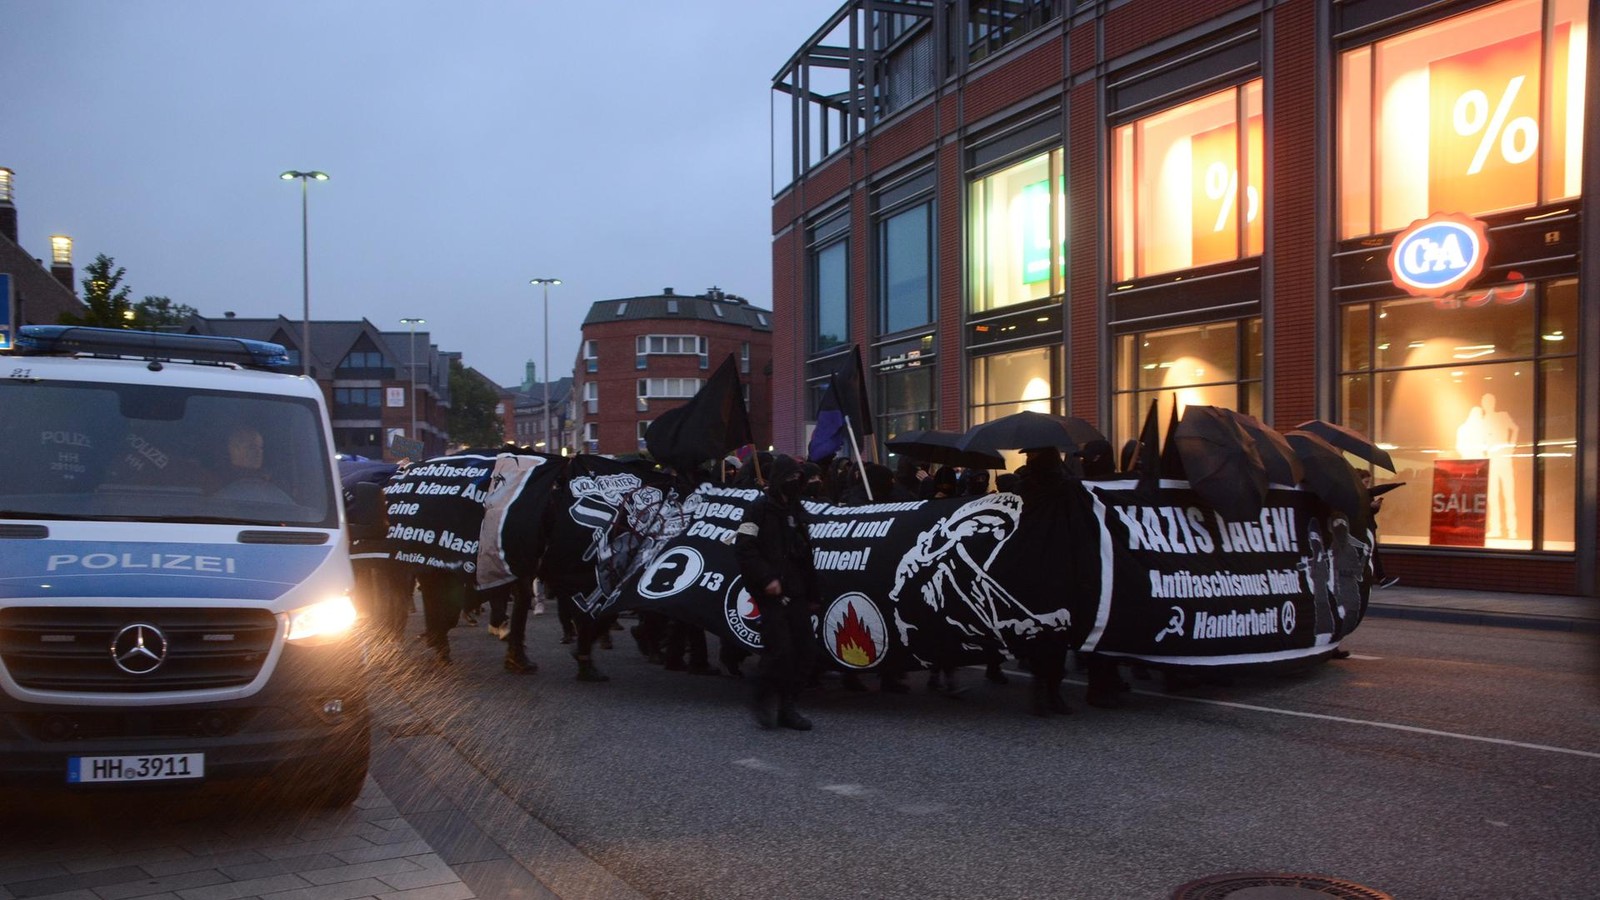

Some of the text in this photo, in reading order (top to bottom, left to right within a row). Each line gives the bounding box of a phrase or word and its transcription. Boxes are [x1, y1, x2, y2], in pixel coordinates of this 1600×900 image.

[1403, 233, 1468, 275] C&A
[408, 463, 488, 478] schönsten
[415, 480, 460, 496] blaue
[460, 482, 487, 507] Au
[1432, 493, 1487, 514] SALE
[387, 501, 420, 515] eine
[851, 517, 896, 539] und
[438, 530, 479, 554] Nase
[46, 552, 236, 574] POLIZEI
[394, 550, 426, 564] Antifa
[699, 571, 725, 592] 13
[1149, 568, 1270, 599] Antifaschismus
[727, 608, 762, 645] NORDER
[1192, 606, 1279, 640] Handarbeit!
[92, 758, 123, 779] HH
[137, 756, 191, 778] 3911
